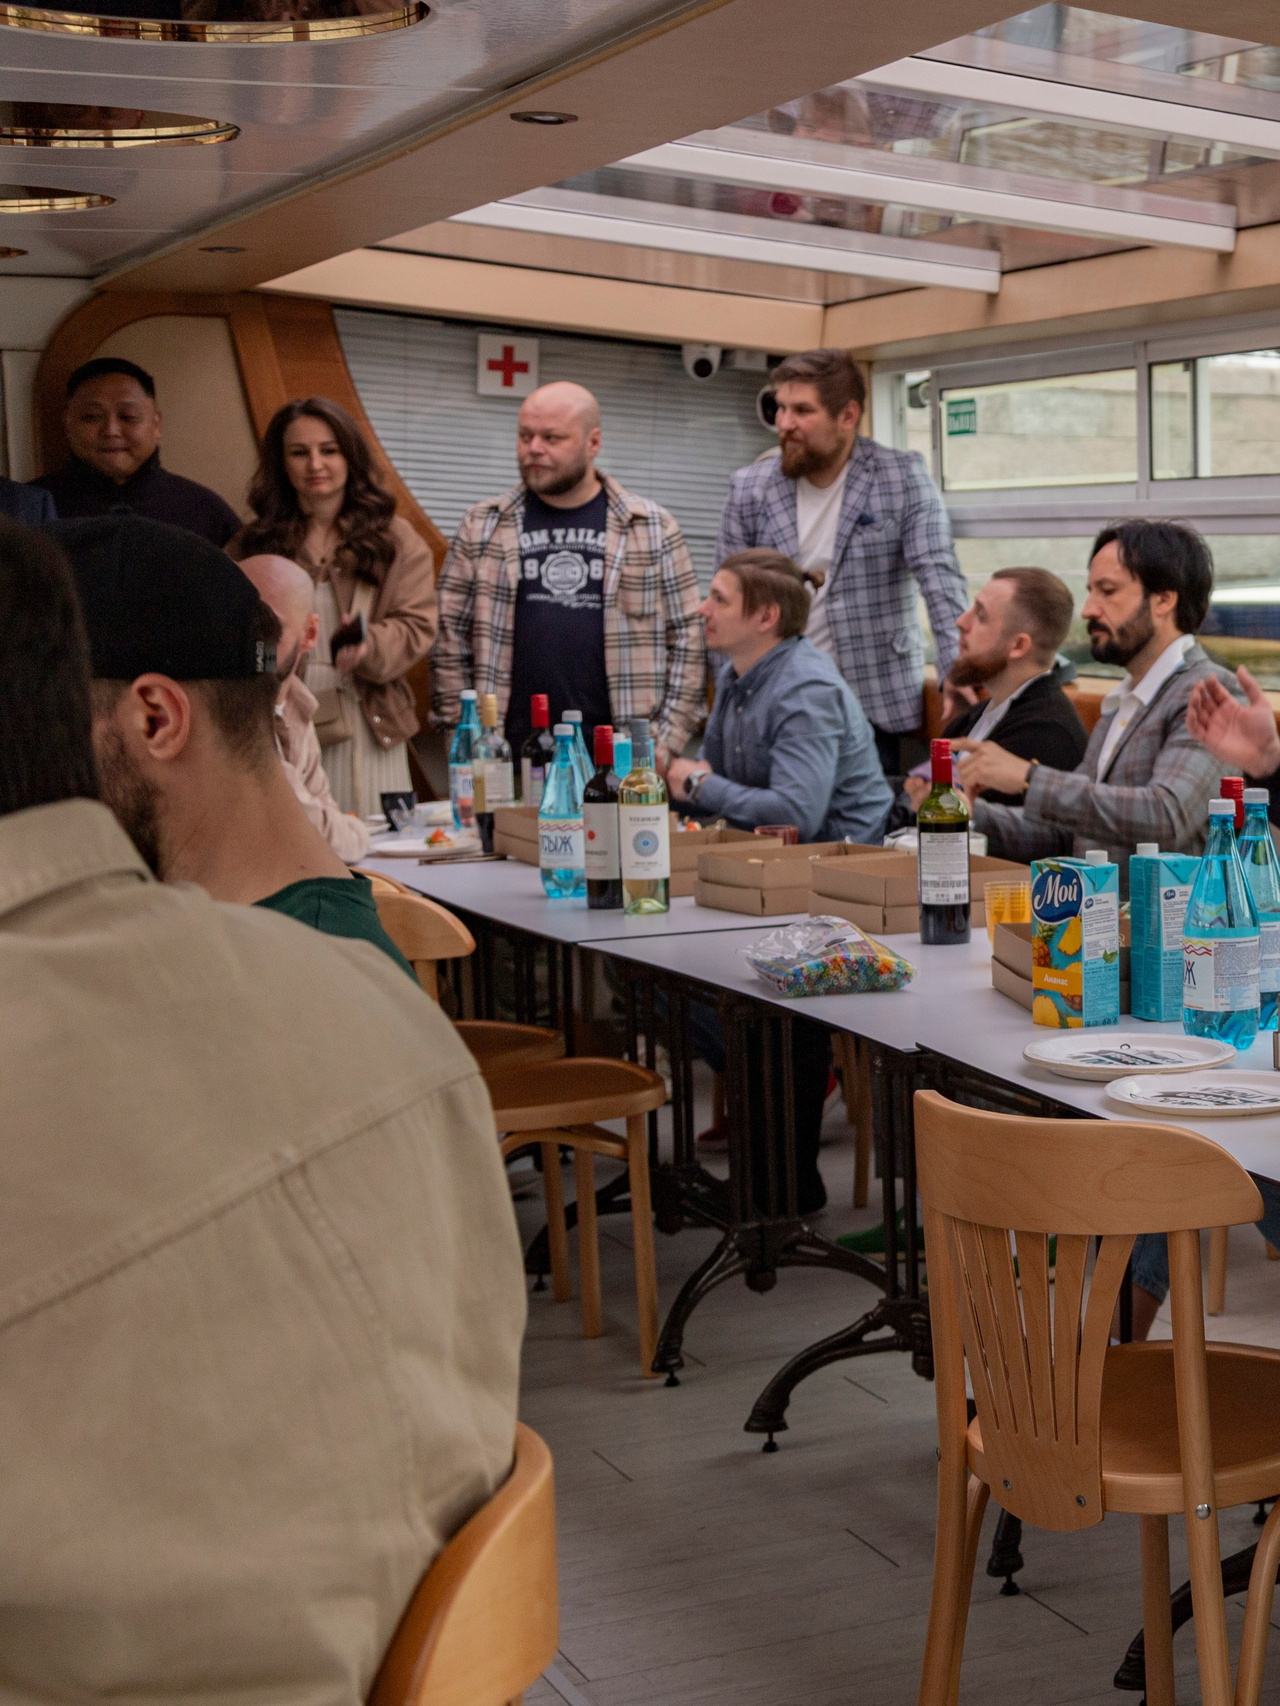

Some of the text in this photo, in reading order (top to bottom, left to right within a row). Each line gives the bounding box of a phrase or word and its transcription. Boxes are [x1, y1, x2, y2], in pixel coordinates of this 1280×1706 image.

[519, 528, 606, 548] OM TAILO
[589, 558, 604, 580] 6
[1033, 873, 1077, 910] Мой
[1043, 973, 1068, 986] Ананас
